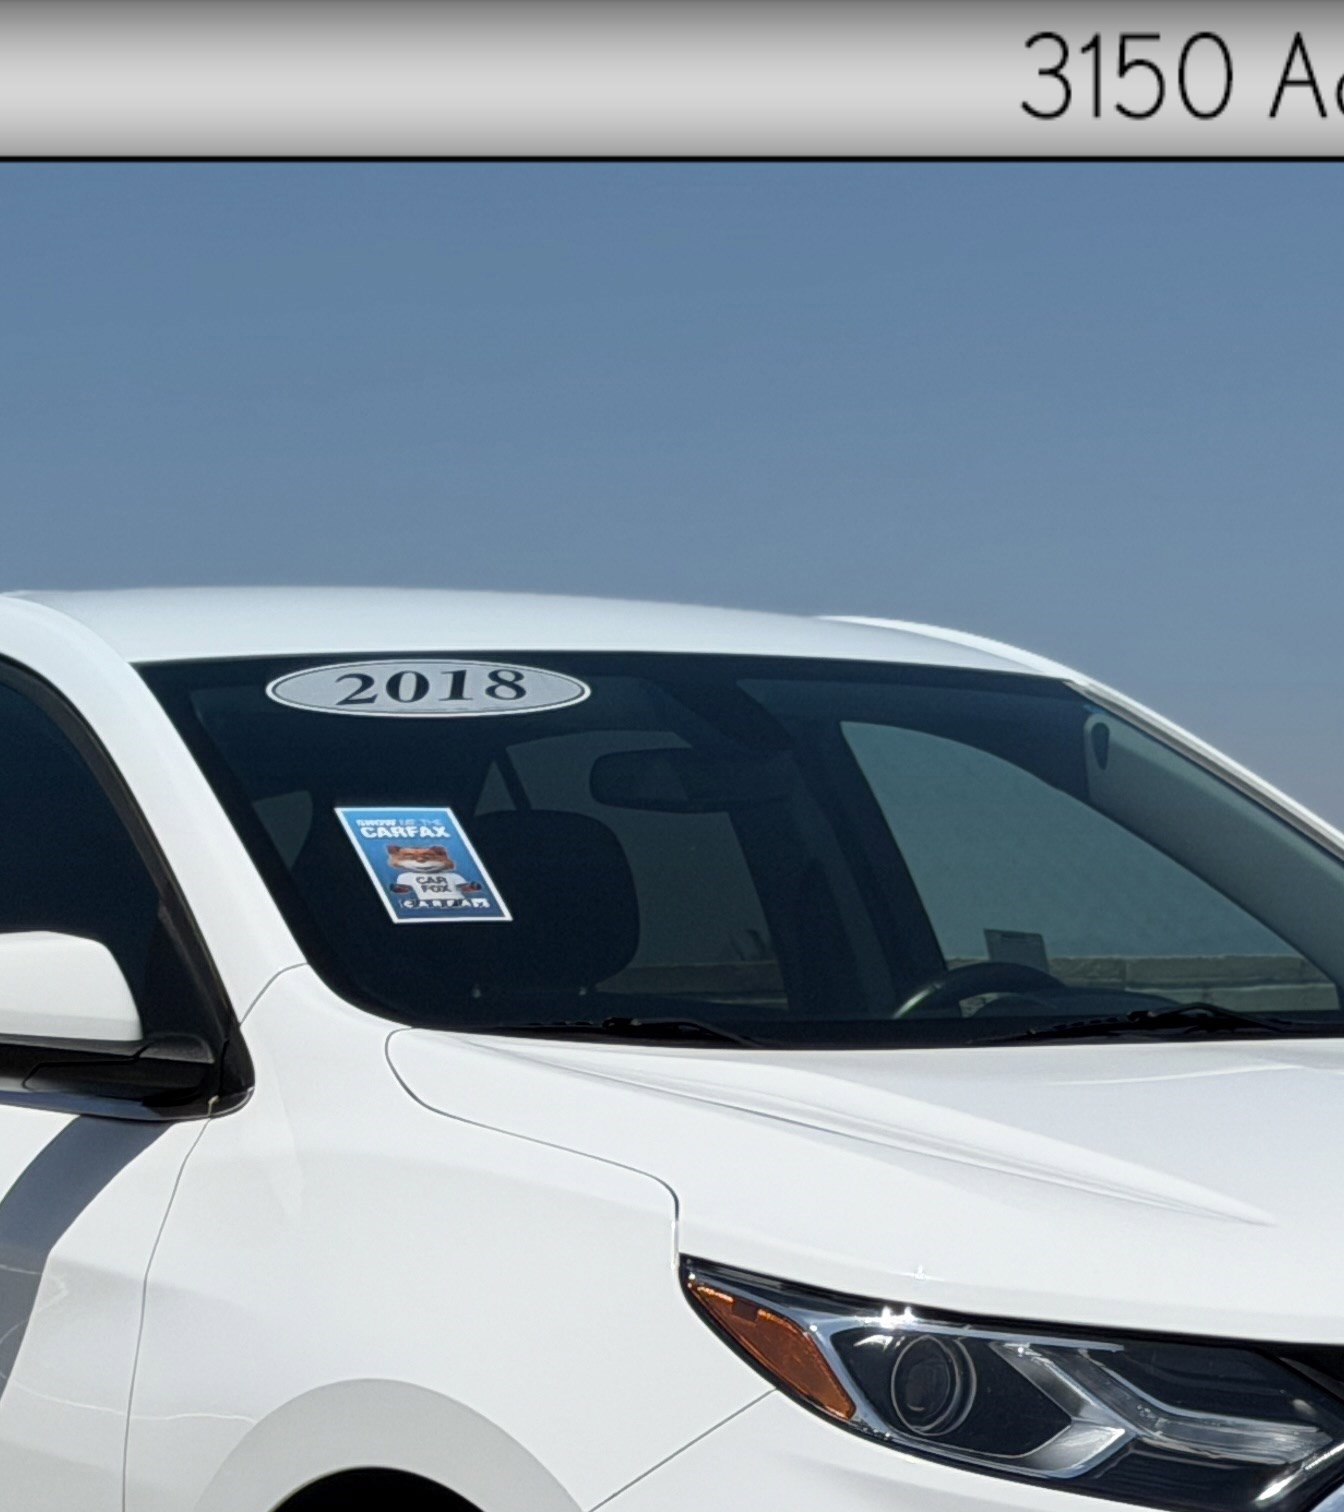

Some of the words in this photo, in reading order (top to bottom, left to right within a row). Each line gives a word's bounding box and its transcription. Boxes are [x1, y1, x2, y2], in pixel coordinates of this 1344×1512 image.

[335, 669, 527, 706] 2018
[360, 826, 452, 838] CARFAX
[416, 876, 448, 885] CAR
[421, 885, 452, 893] FOX
